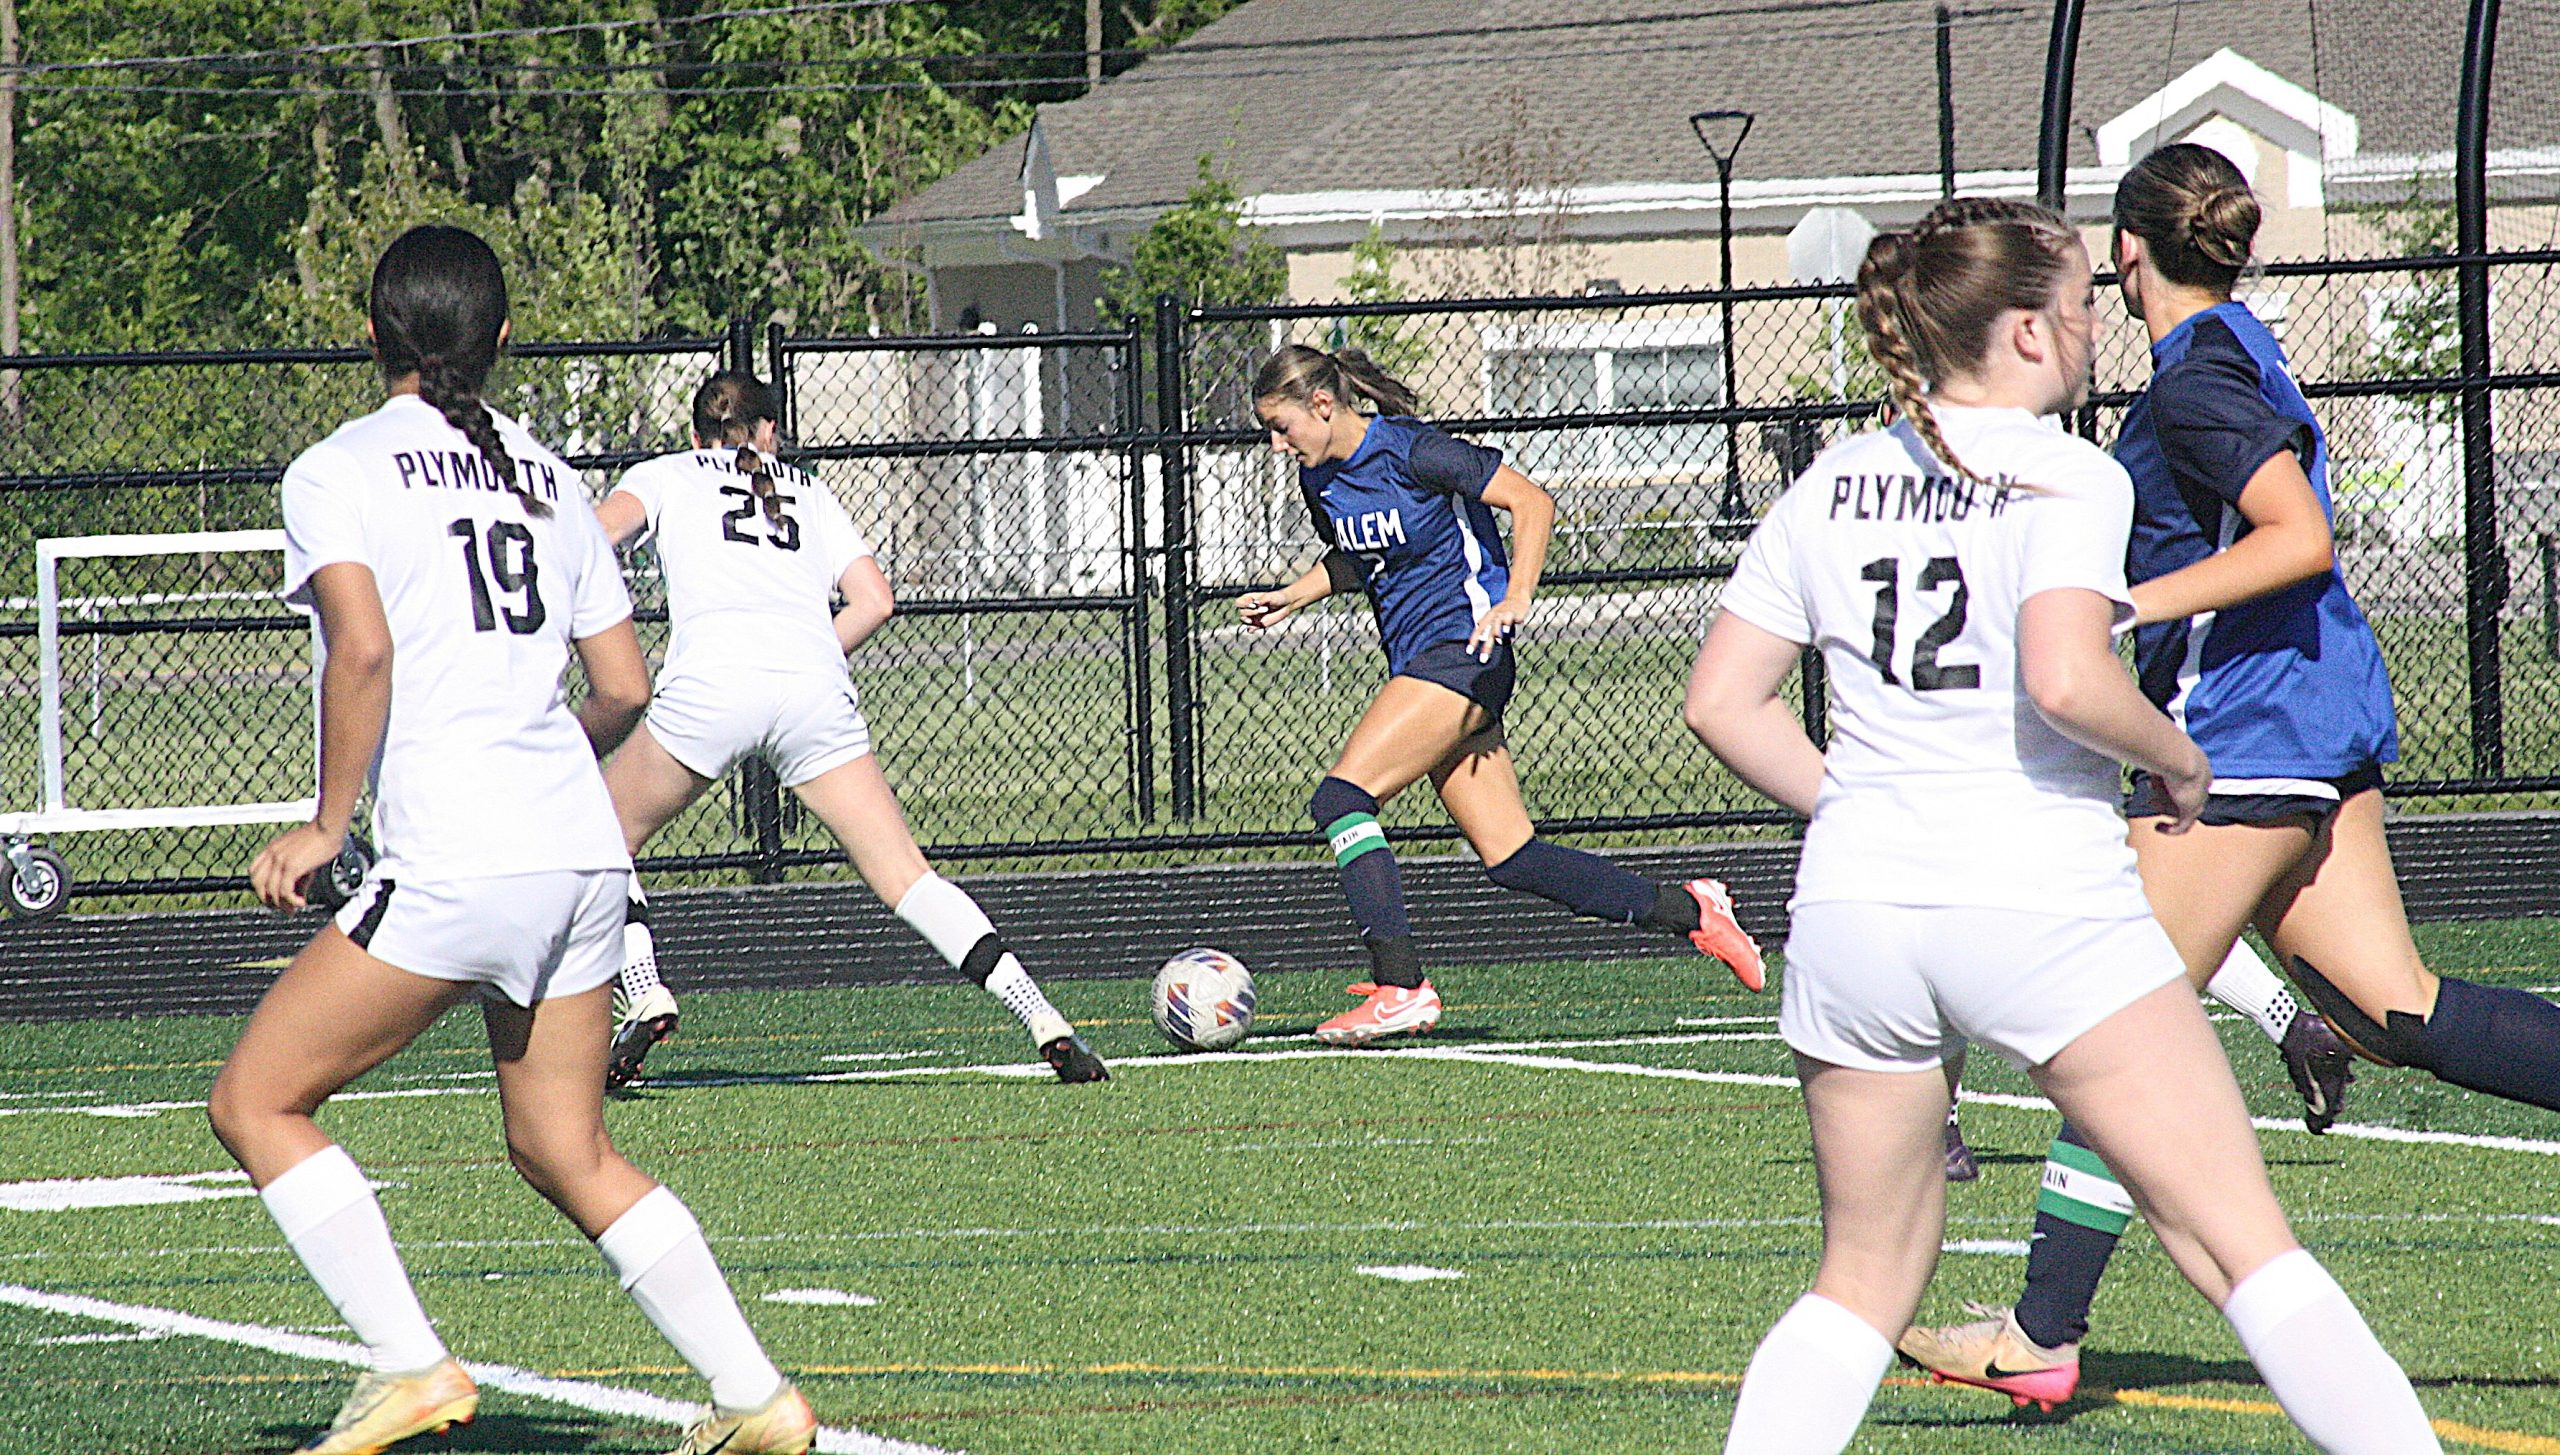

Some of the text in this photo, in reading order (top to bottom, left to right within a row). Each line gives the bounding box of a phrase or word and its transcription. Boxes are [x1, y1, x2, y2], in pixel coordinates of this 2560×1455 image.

[393, 450, 559, 501] PLYMOTH
[1829, 471, 2018, 524] PLYMOUH
[719, 485, 801, 551] 25
[1332, 507, 1407, 552] ALEM
[447, 518, 547, 636] 19
[1861, 556, 1981, 691] 12
